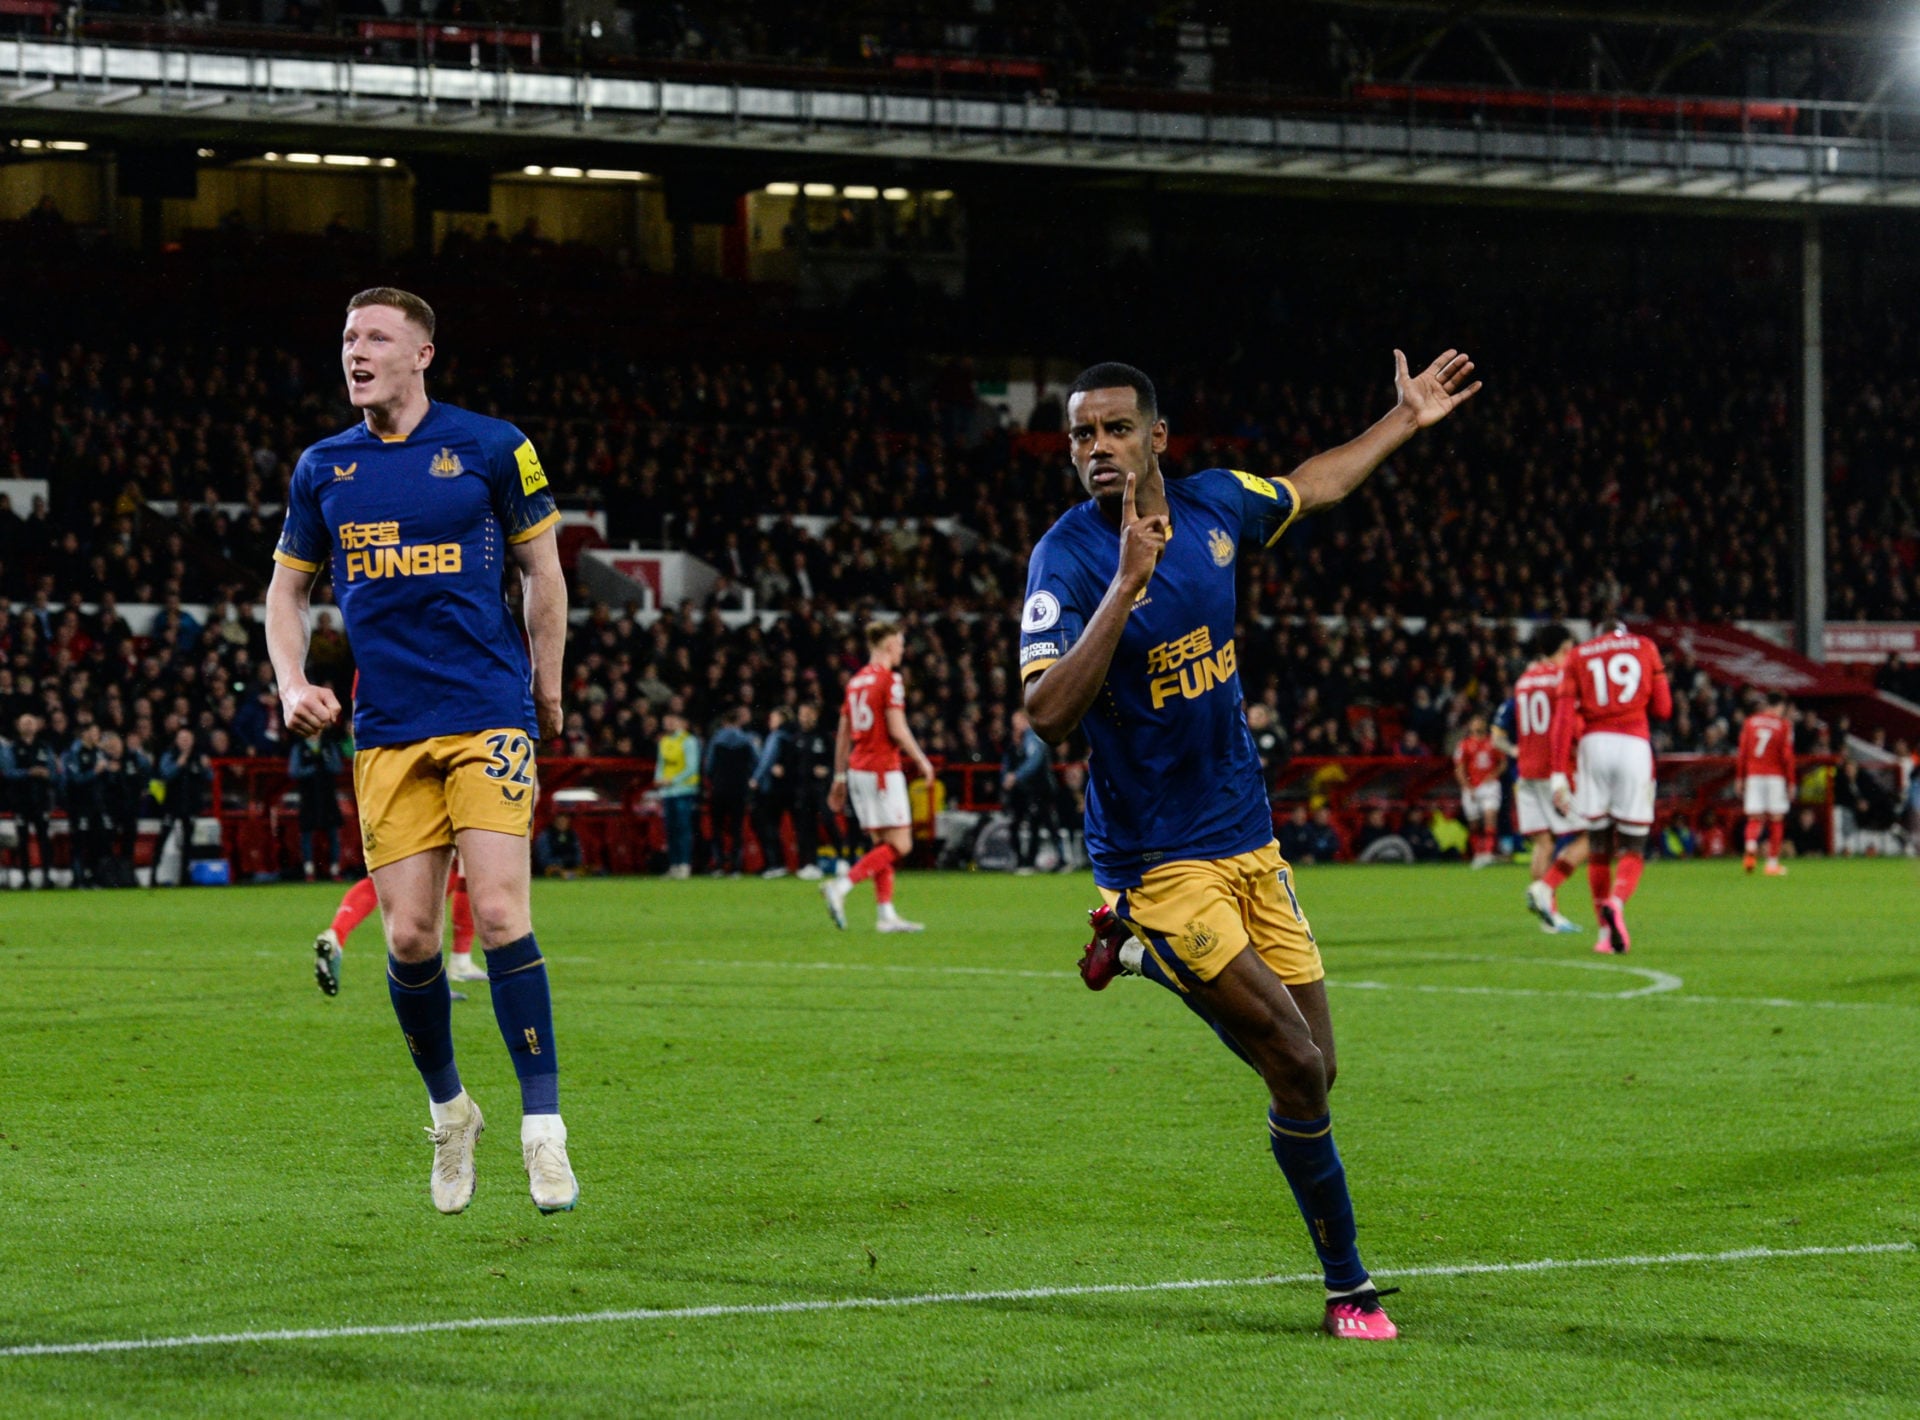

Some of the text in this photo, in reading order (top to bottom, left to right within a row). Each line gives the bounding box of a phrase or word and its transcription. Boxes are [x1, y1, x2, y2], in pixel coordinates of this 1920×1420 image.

[339, 521, 400, 550] 乐天堂
[346, 543, 462, 581] FUN88
[1147, 625, 1213, 675] 乐天堂
[1586, 653, 1641, 706] 19
[848, 689, 874, 732] 16
[1517, 690, 1551, 736] 10
[483, 732, 532, 786] 32
[1754, 728, 1773, 758] 7
